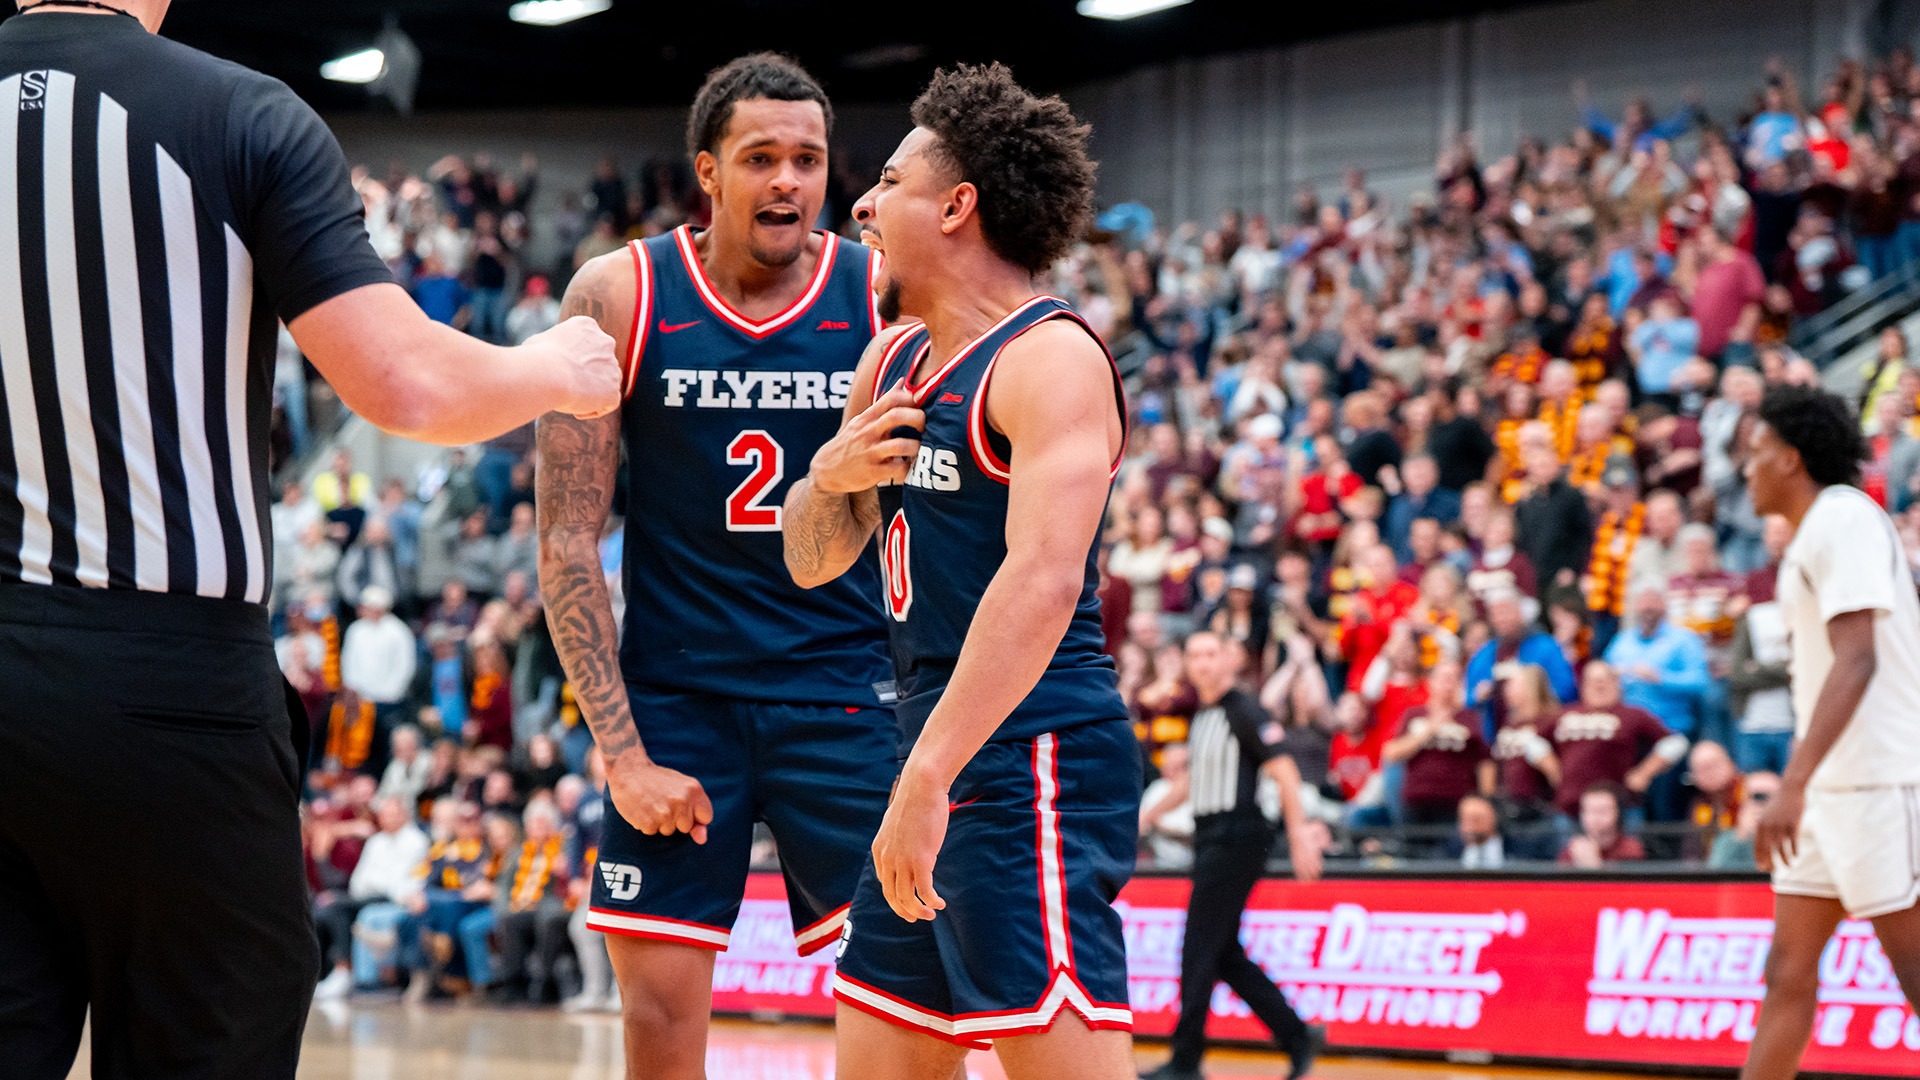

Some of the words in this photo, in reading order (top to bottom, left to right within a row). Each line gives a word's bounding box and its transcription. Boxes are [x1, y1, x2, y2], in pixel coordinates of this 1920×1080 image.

[20, 101, 43, 111] USA
[661, 369, 856, 409] FLYERS
[726, 429, 784, 532] 2
[884, 507, 913, 622] 0
[1319, 903, 1493, 976] DIRECT
[1593, 907, 1902, 990] WAREUS
[1585, 995, 1854, 1047] WORKPLE
